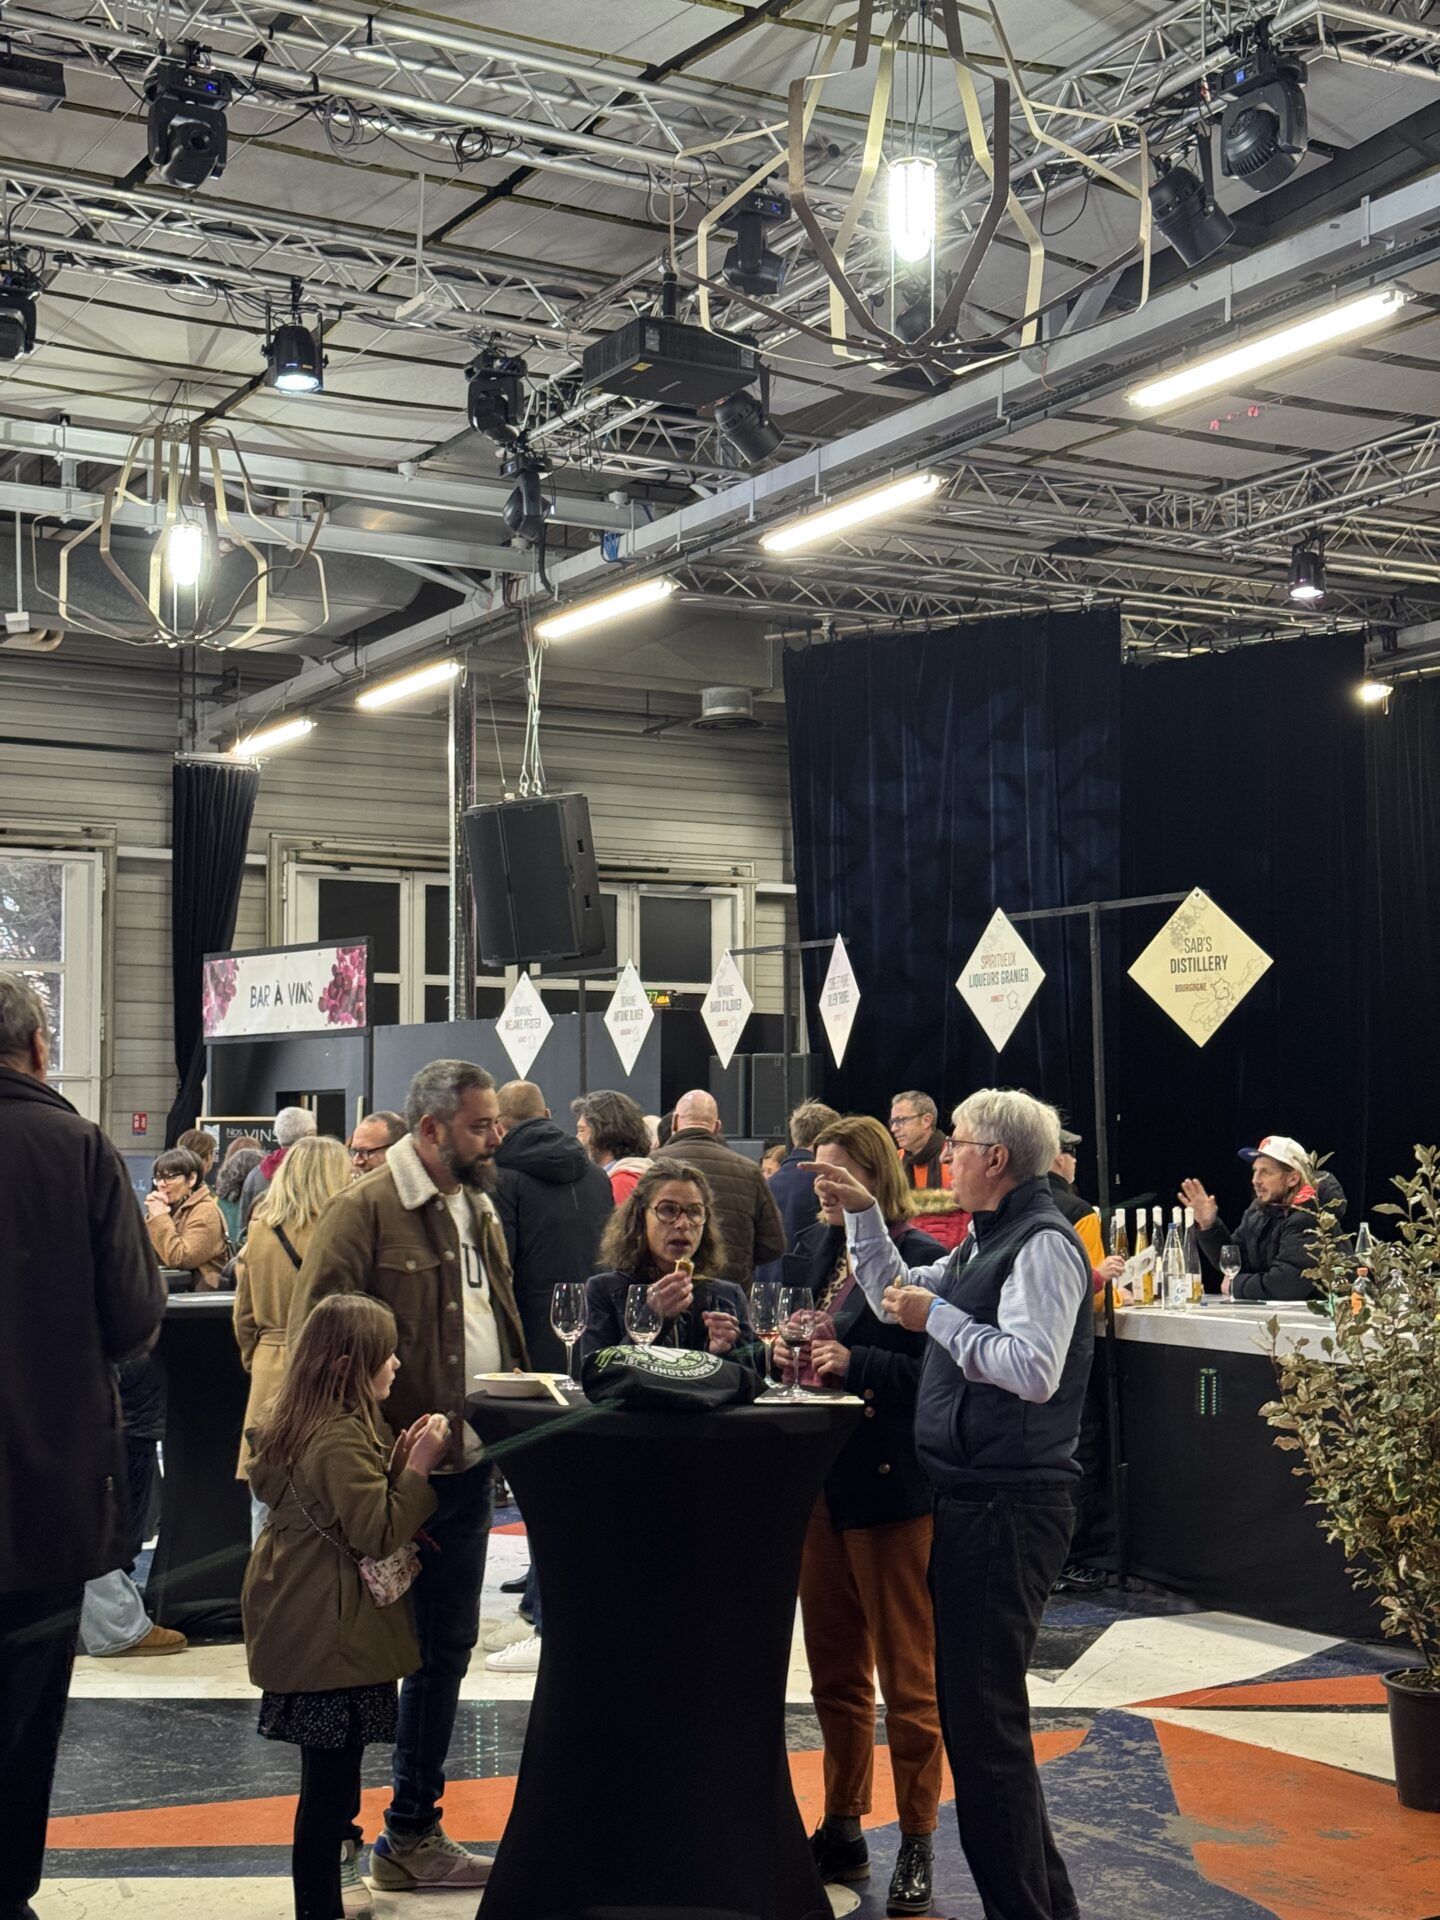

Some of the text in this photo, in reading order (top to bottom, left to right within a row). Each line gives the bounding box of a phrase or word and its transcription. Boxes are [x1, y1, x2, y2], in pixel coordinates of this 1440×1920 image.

[1184, 936, 1212, 953] SAB'S
[1170, 955, 1228, 974] DISTILLERY
[968, 968, 1029, 988] LIQUEURS GRANIER
[250, 979, 313, 1008] BAR À VINS
[649, 1364, 715, 1377] UNDERDOGS
